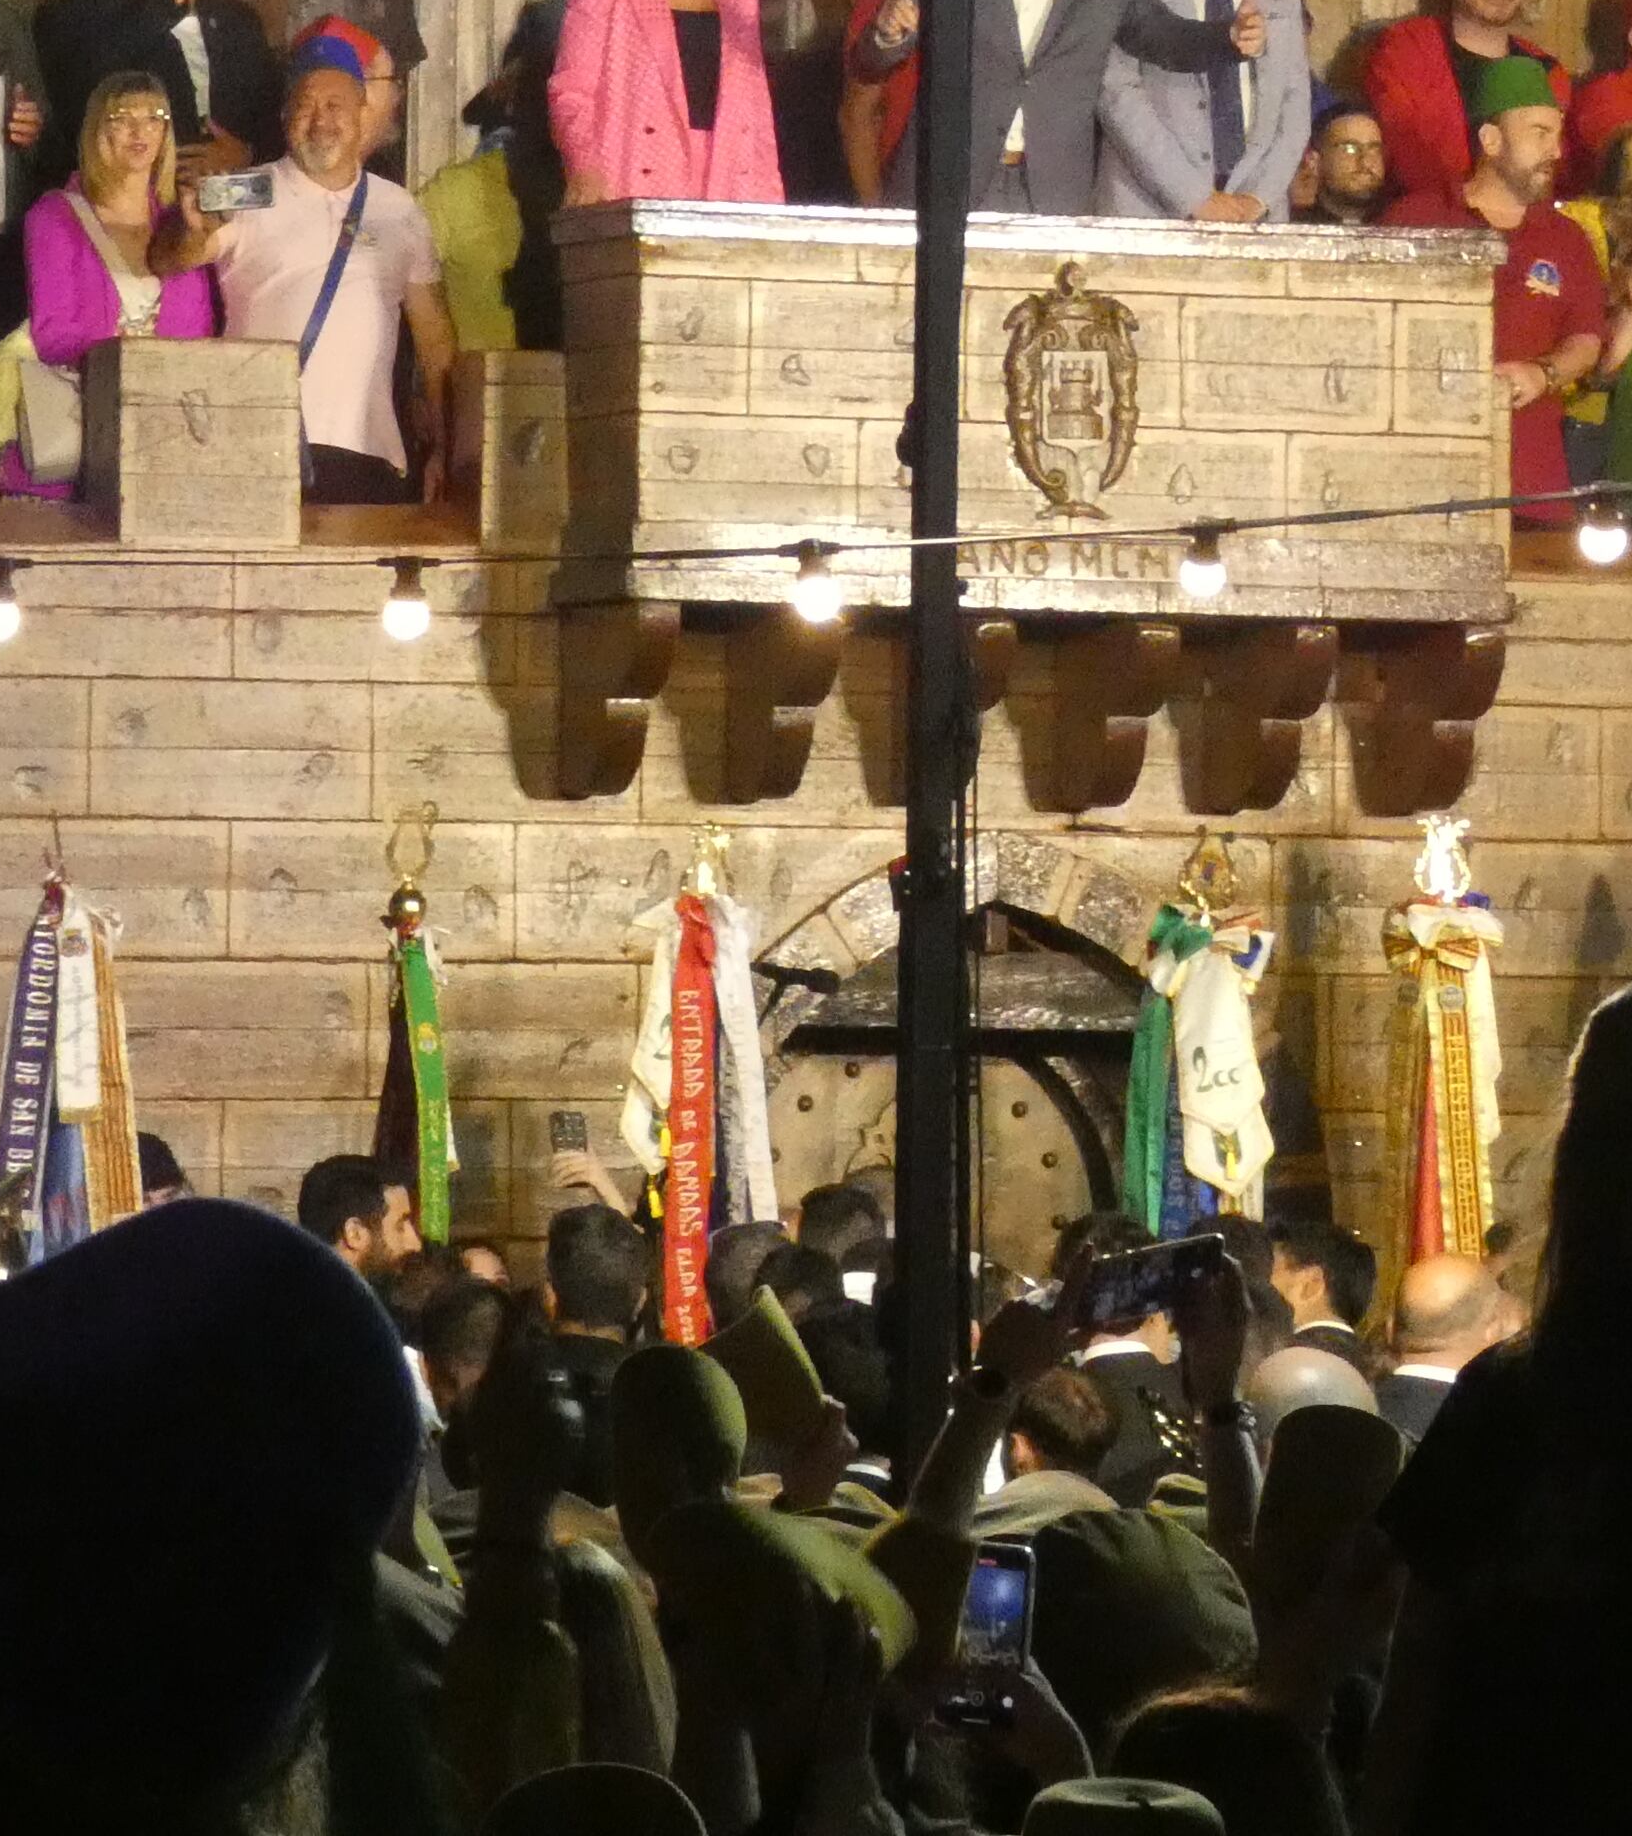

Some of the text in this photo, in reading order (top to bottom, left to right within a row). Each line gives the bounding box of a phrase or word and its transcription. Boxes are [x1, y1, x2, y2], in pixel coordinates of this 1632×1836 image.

[677, 989, 705, 1099] ENTRADA
[14, 1060, 43, 1086] DE
[1191, 1045, 1242, 1094] 2cc
[8, 1097, 39, 1136] SAN
[679, 1108, 698, 1131] DE
